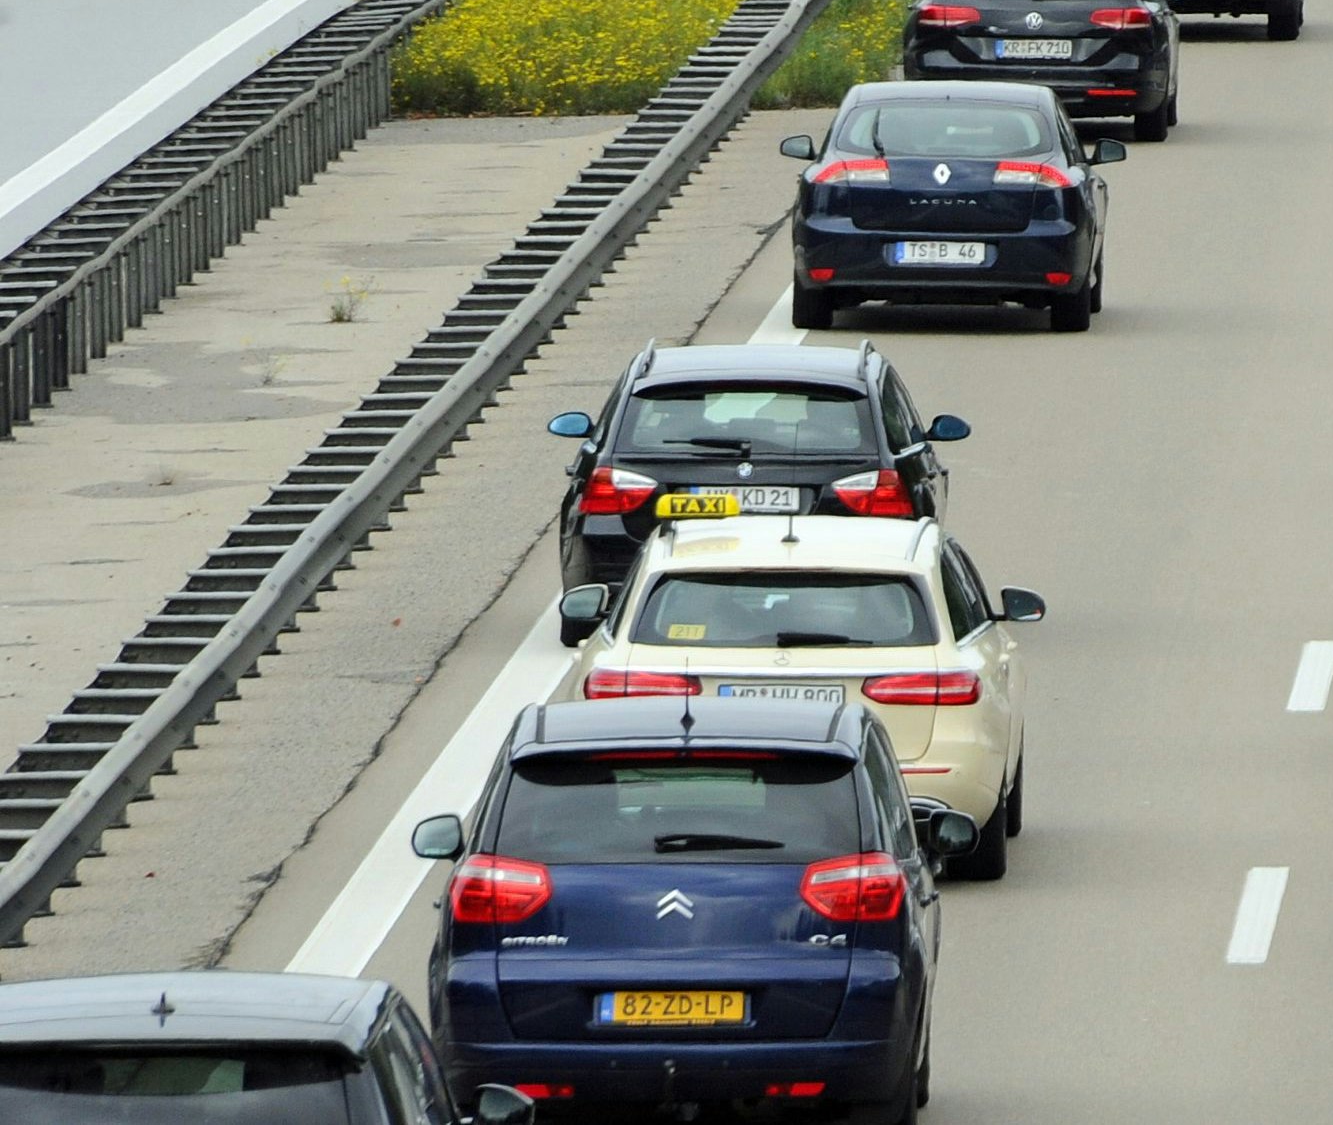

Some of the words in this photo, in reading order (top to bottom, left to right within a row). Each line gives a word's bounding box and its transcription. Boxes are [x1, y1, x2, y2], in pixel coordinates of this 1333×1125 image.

[909, 244, 928, 258] TS
[938, 244, 948, 258] B
[958, 245, 976, 258] 46
[671, 497, 726, 514] TAXI
[742, 488, 765, 506] KD
[770, 489, 792, 507] 21
[622, 993, 734, 1016] 82-ZD-LP
